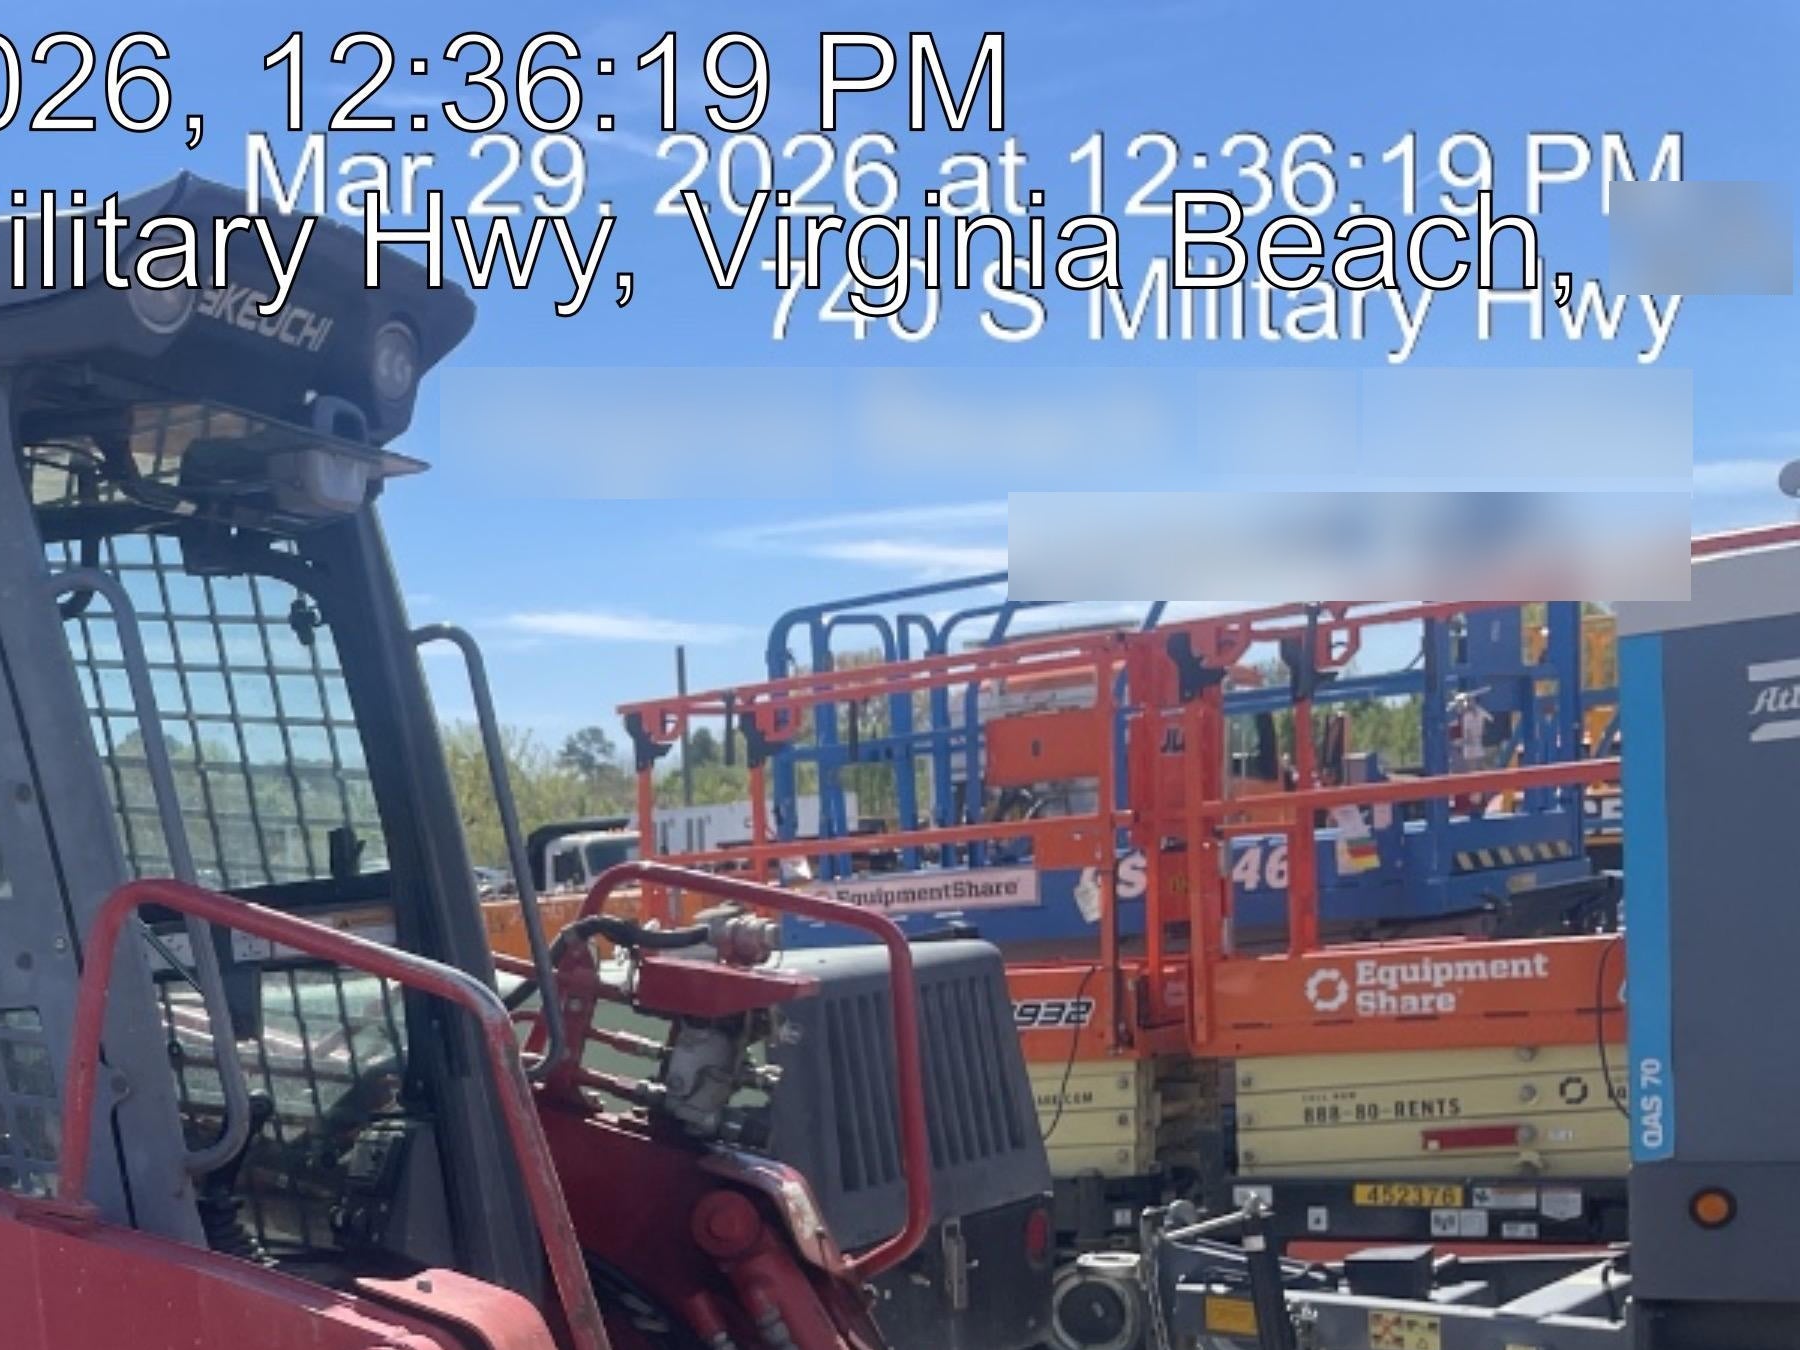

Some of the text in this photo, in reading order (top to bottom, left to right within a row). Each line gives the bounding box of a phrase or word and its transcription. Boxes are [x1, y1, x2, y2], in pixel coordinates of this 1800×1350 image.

[197, 275, 334, 351] AKEUCHI
[837, 879, 1019, 908] EquipmentShare
[1356, 953, 1549, 991] Equipment
[1356, 989, 1456, 1017] Share
[1640, 1057, 1664, 1148] QAS 70
[1367, 1184, 1456, 1207] 452376
